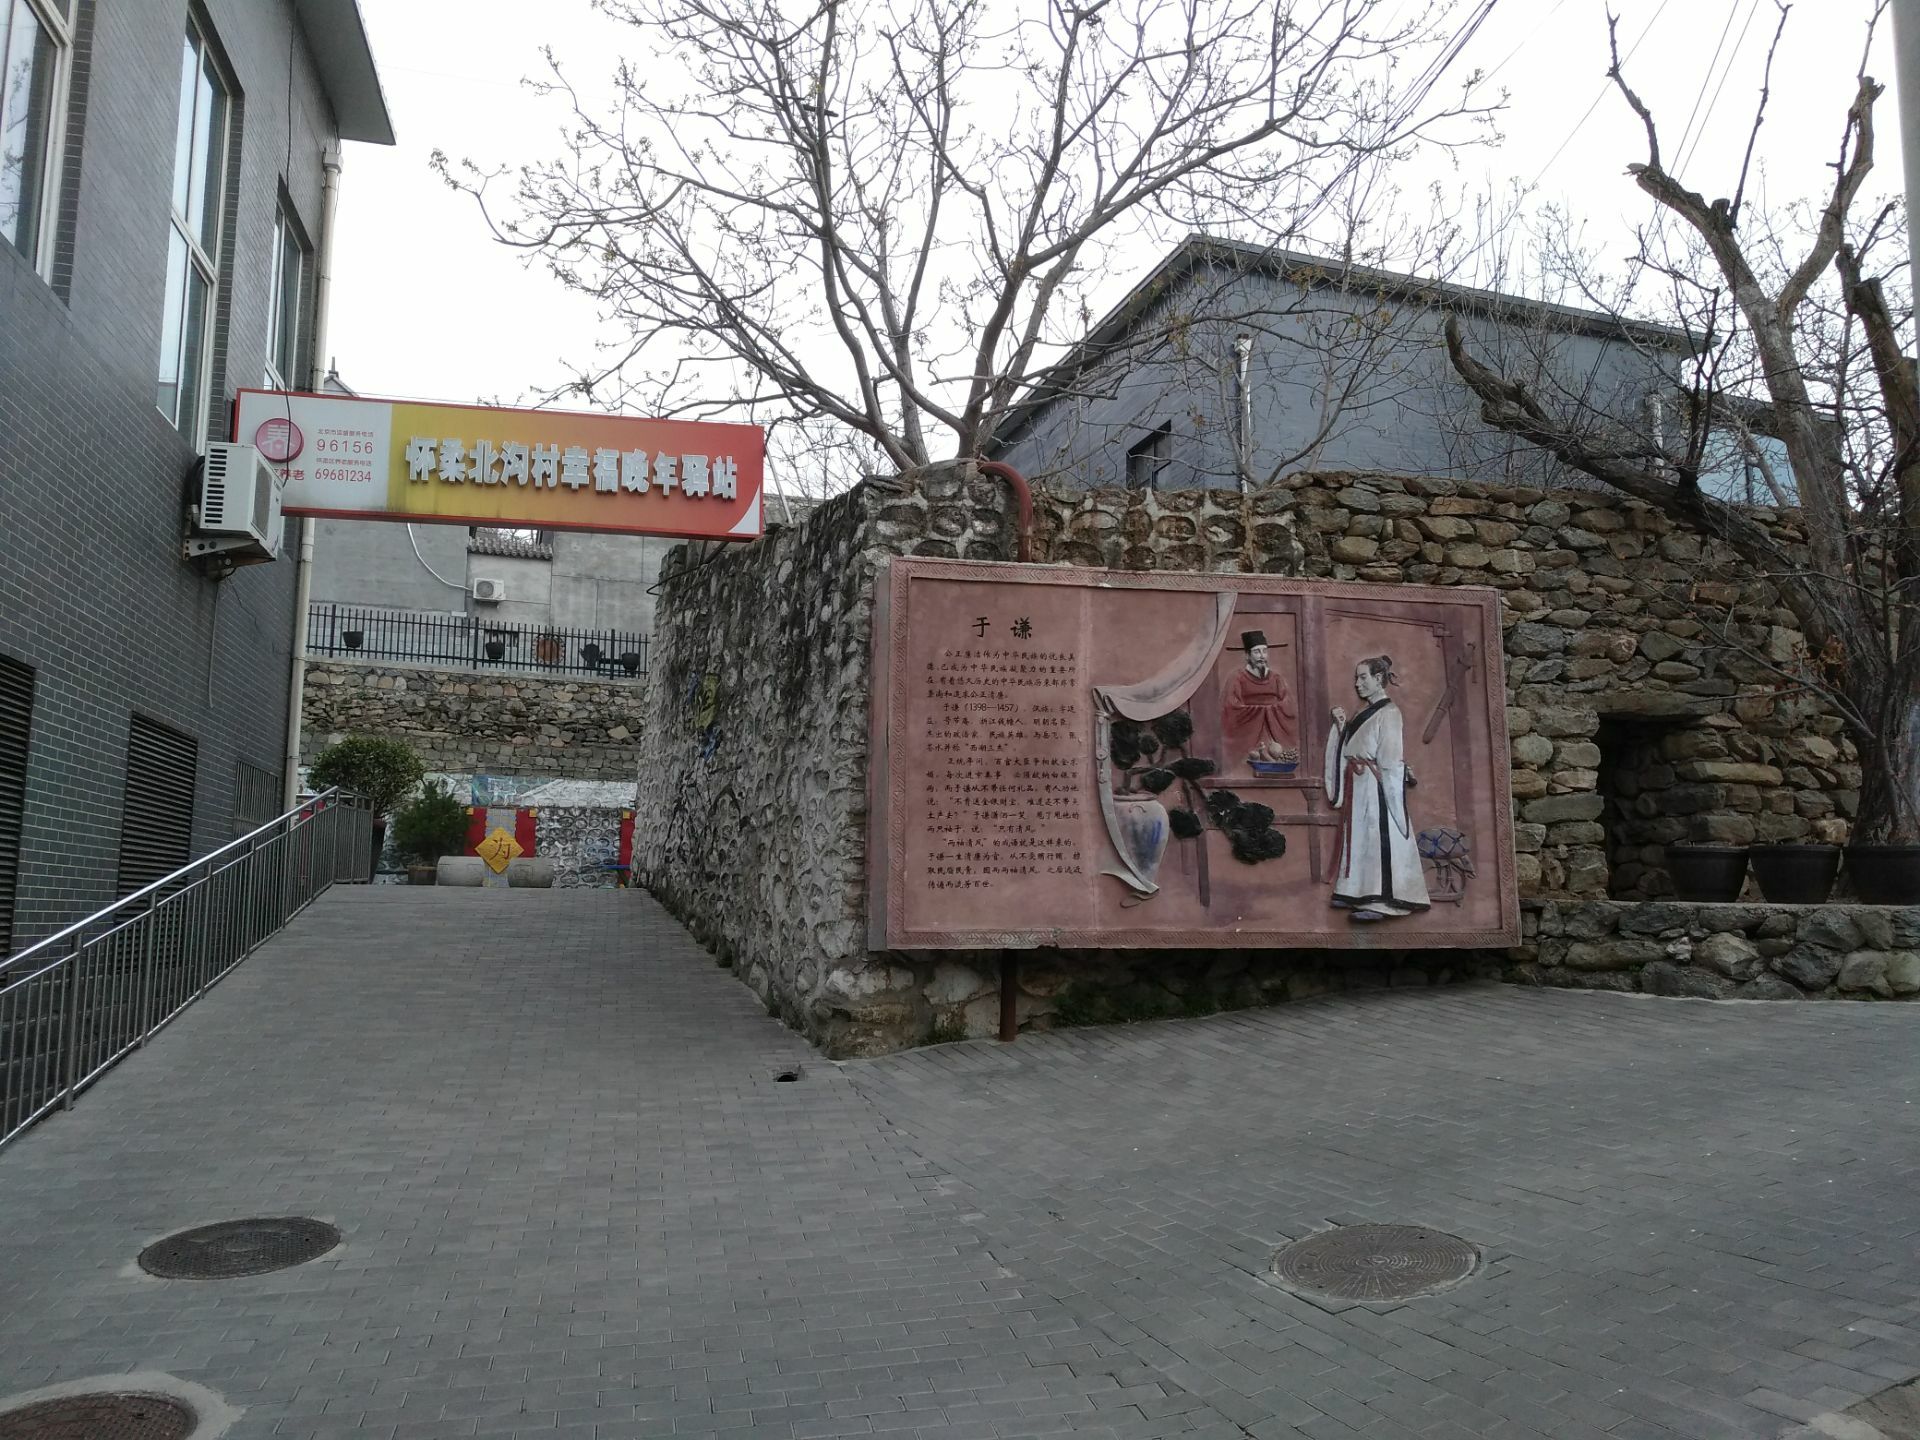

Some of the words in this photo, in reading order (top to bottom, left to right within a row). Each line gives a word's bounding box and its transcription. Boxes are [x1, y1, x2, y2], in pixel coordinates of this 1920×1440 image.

[316, 438, 373, 454] 96156
[314, 468, 372, 483] 69681234
[405, 436, 738, 500] 怀柔北沟村幸福晚年驿站
[971, 616, 1033, 640] 于谦
[491, 837, 511, 861] 为
